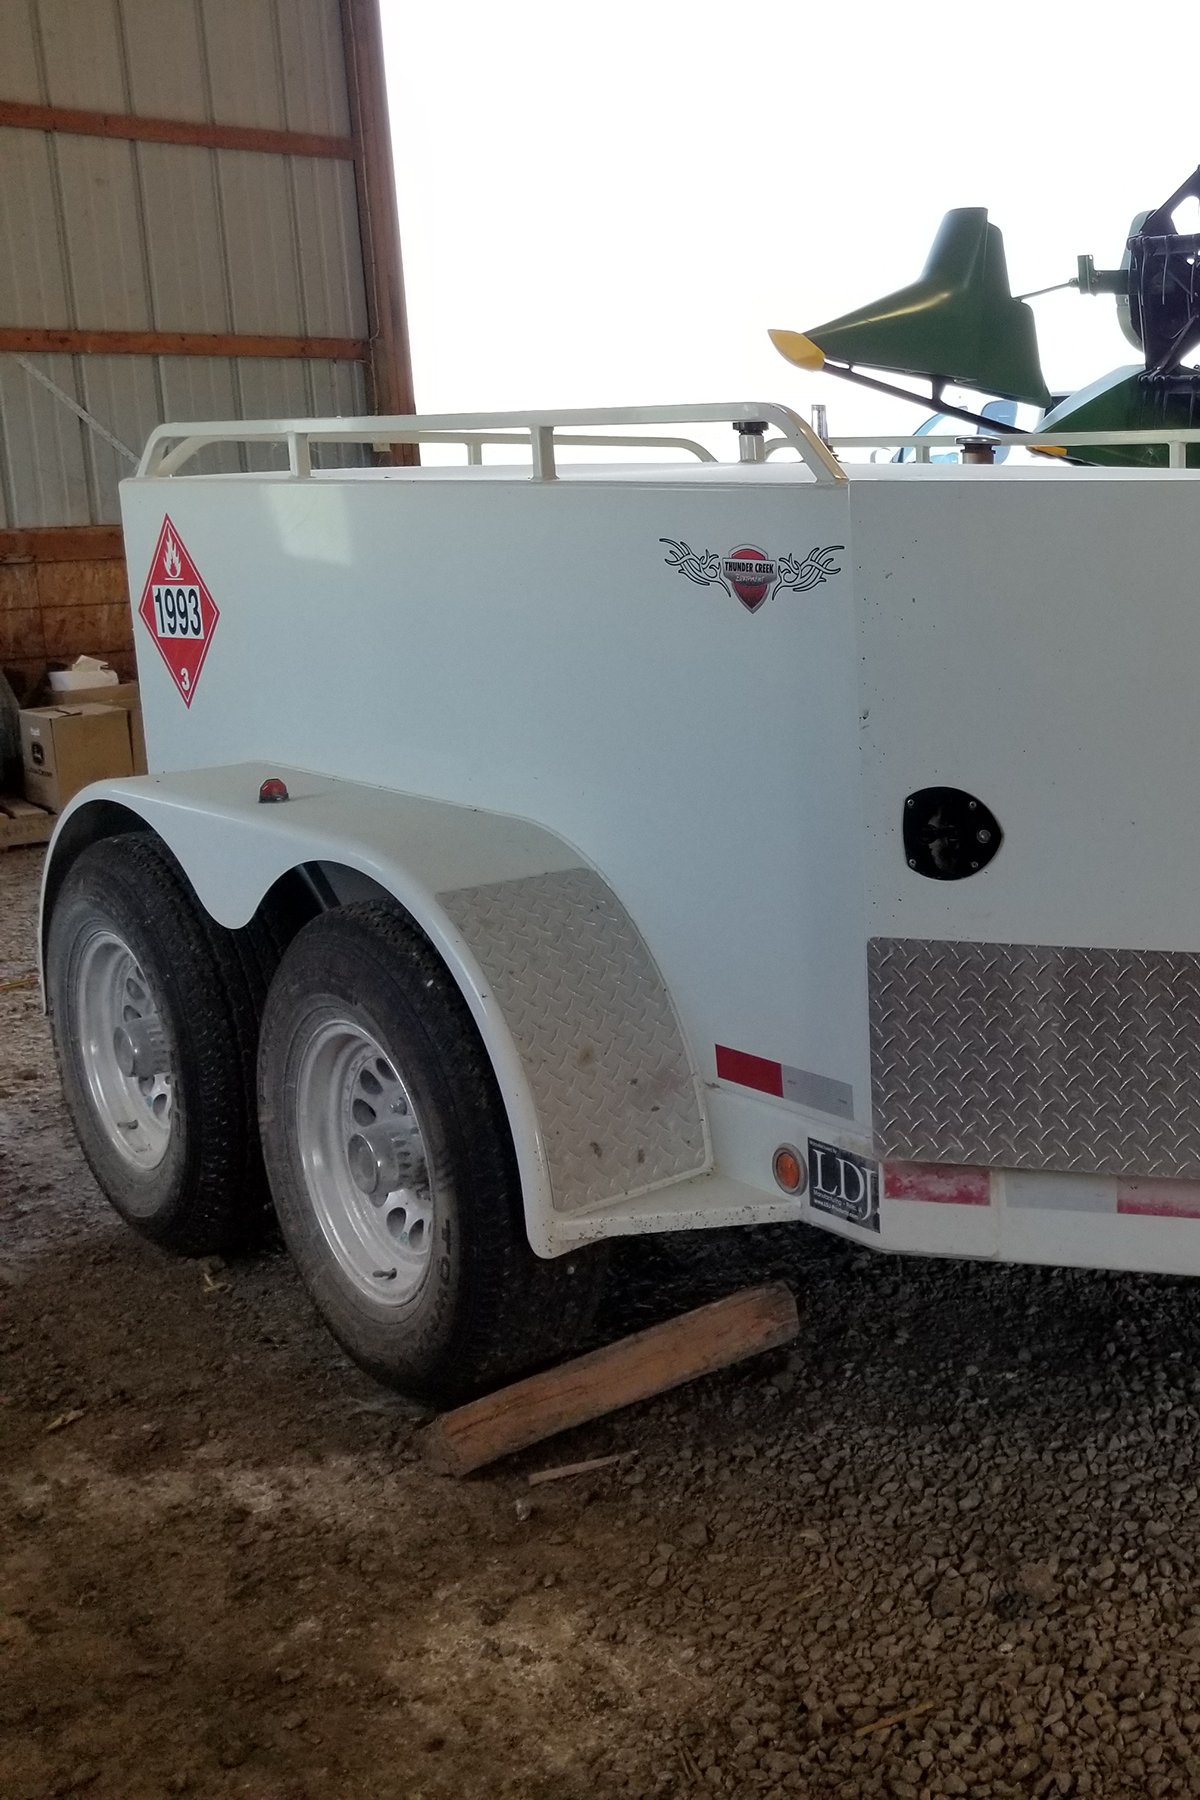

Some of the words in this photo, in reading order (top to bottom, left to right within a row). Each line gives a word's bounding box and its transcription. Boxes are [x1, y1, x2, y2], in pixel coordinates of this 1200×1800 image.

[725, 561, 753, 573] THUNDER
[754, 562, 774, 574] CREEK
[155, 588, 201, 636] 1993
[180, 667, 190, 691] 3
[812, 1148, 878, 1221] LDJ
